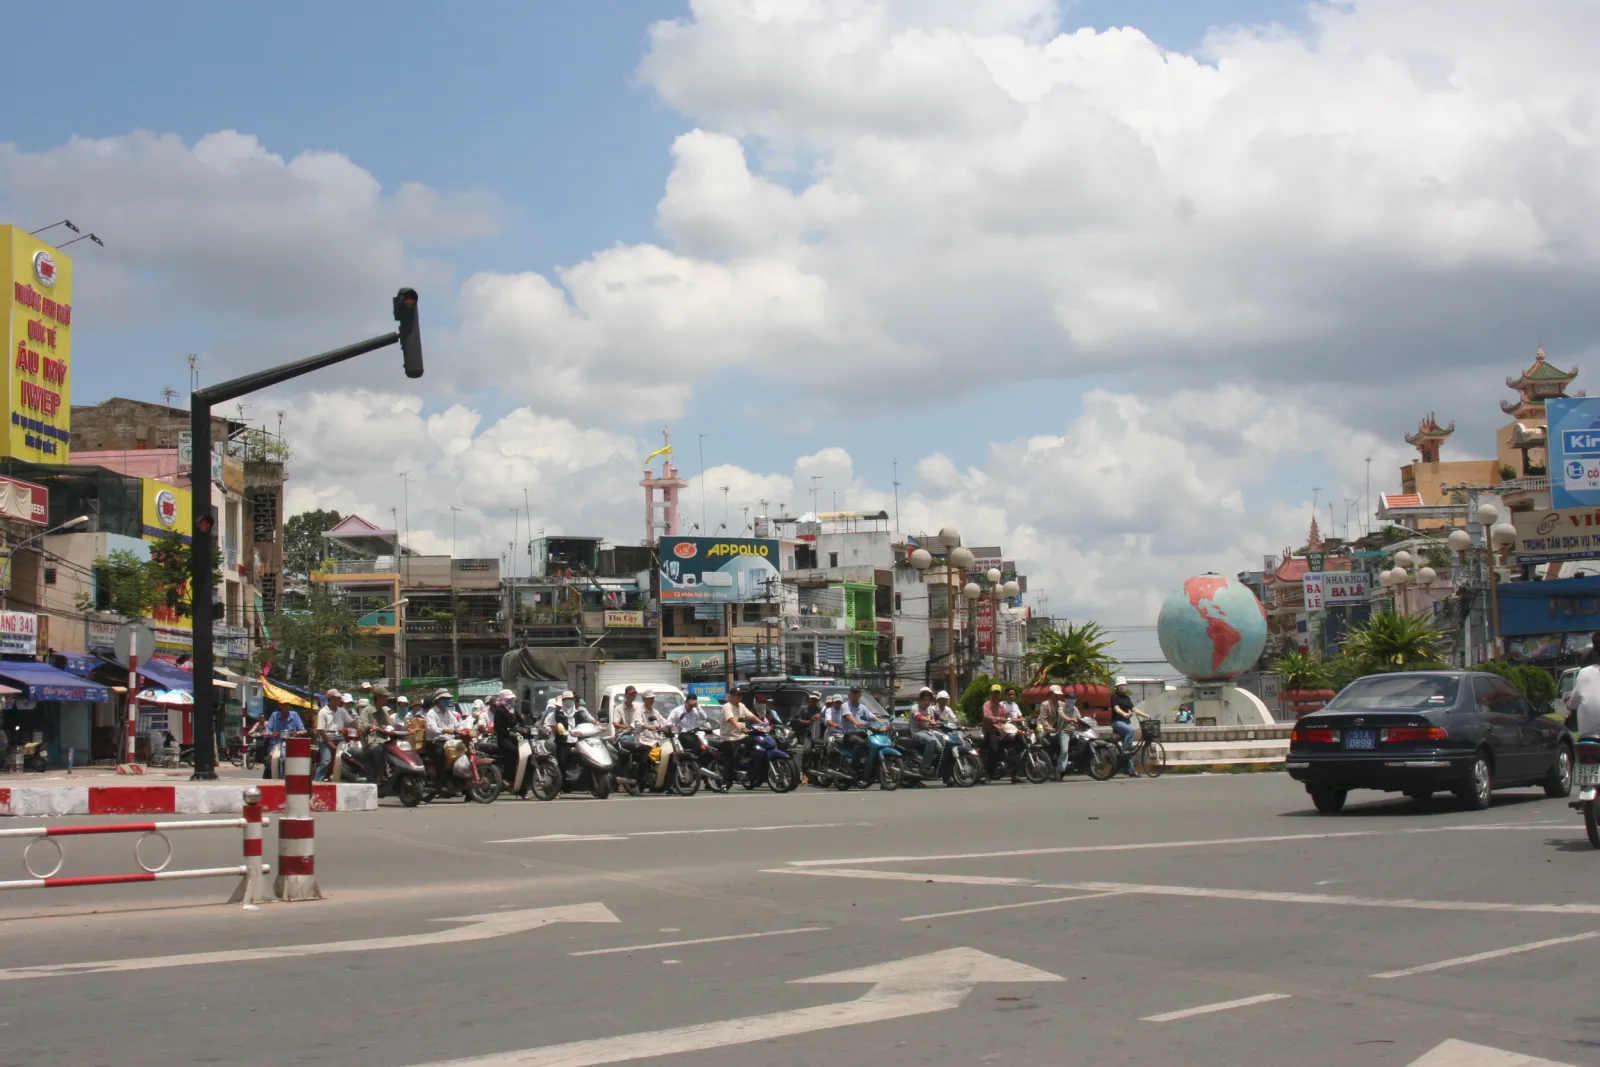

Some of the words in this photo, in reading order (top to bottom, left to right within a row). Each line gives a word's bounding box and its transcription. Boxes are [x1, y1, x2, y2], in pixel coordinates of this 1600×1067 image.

[21, 380, 61, 417] IWEP
[1523, 538, 1546, 550] TRUNG
[1547, 536, 1562, 549] TÂM
[1563, 535, 1579, 551] DỊCH
[1580, 534, 1591, 550] VỤ
[708, 543, 769, 557] APPOLLO
[1325, 575, 1343, 585] NHA
[1344, 573, 1368, 584] KHOA
[1306, 584, 1321, 594] BA
[1331, 587, 1347, 597] BA
[1349, 583, 1364, 596] LÊ
[1308, 595, 1321, 608] LÊ
[19, 615, 34, 634] 341
[701, 660, 719, 669] MILO
[1349, 738, 1372, 748] 0899
